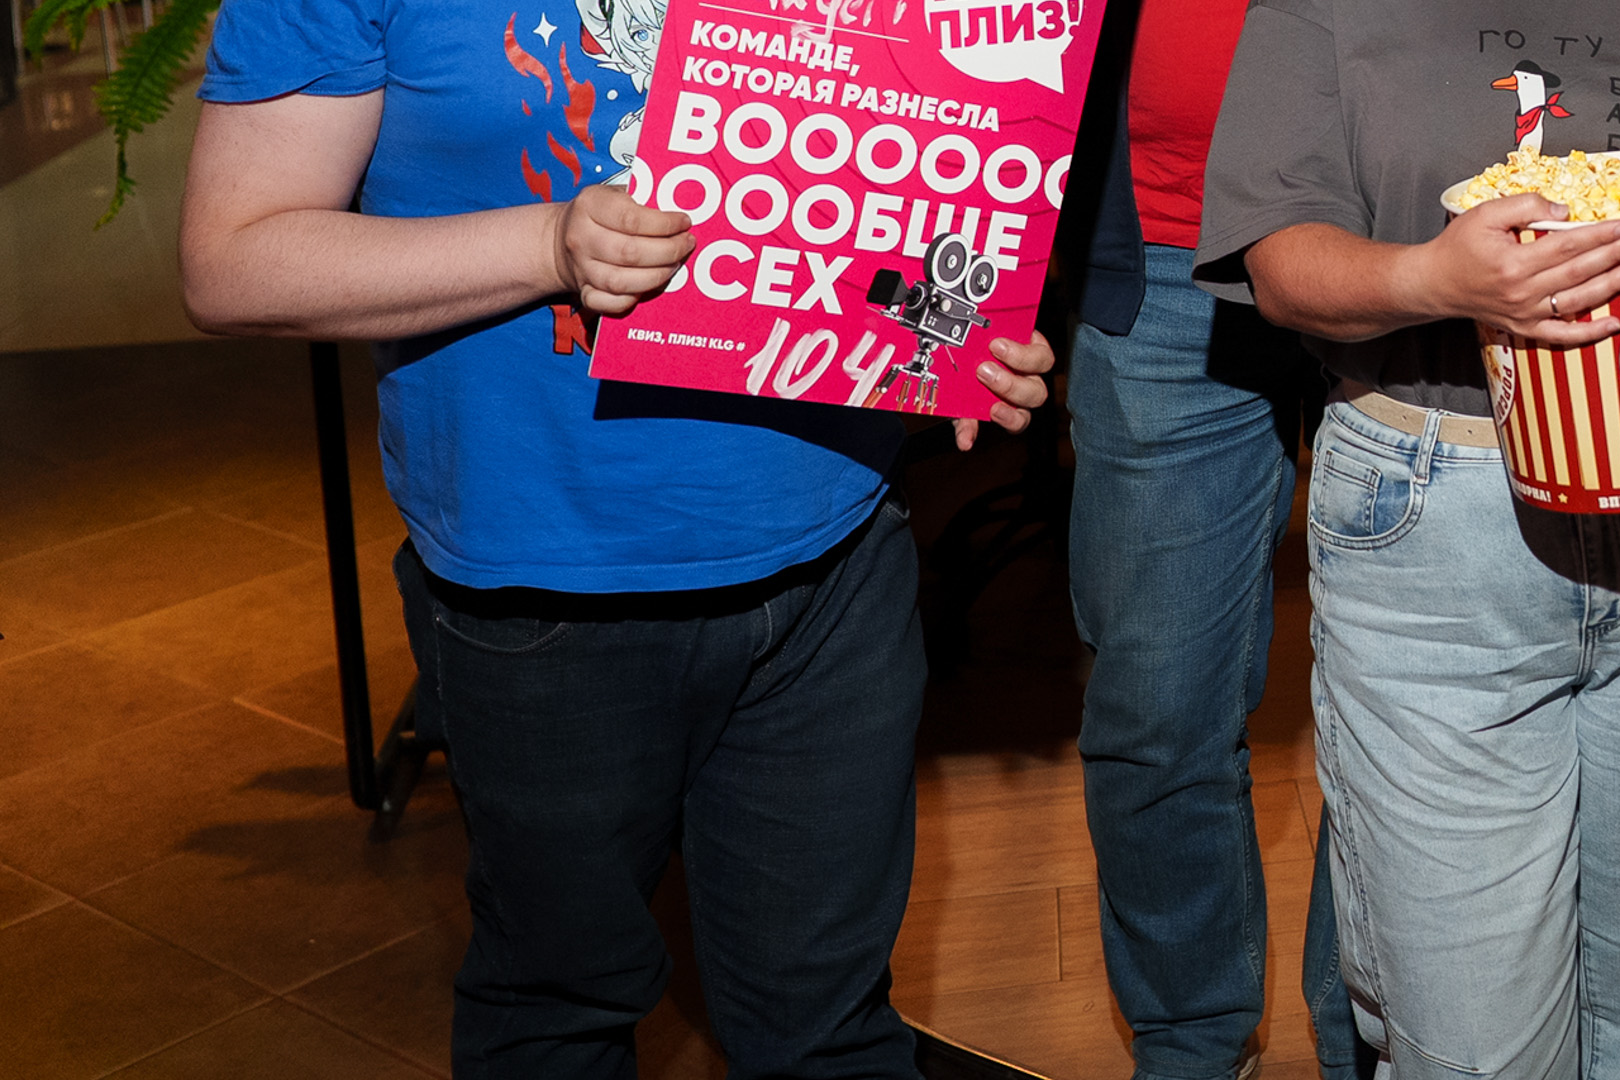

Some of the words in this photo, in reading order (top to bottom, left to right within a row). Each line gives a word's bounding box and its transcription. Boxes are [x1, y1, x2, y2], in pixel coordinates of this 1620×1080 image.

[690, 20, 860, 76] КОМАНДЕ,
[1479, 29, 1526, 52] ГО
[1553, 35, 1603, 57] ТУ
[682, 56, 836, 105] КОТОРАЯ
[840, 83, 1000, 133] РАЗНЕСЛА
[664, 238, 854, 316] СЕХ
[627, 328, 665, 344] КВИЗ,
[667, 332, 707, 347] ПЛИЗ!
[708, 336, 734, 351] KLG
[744, 317, 896, 408] 104
